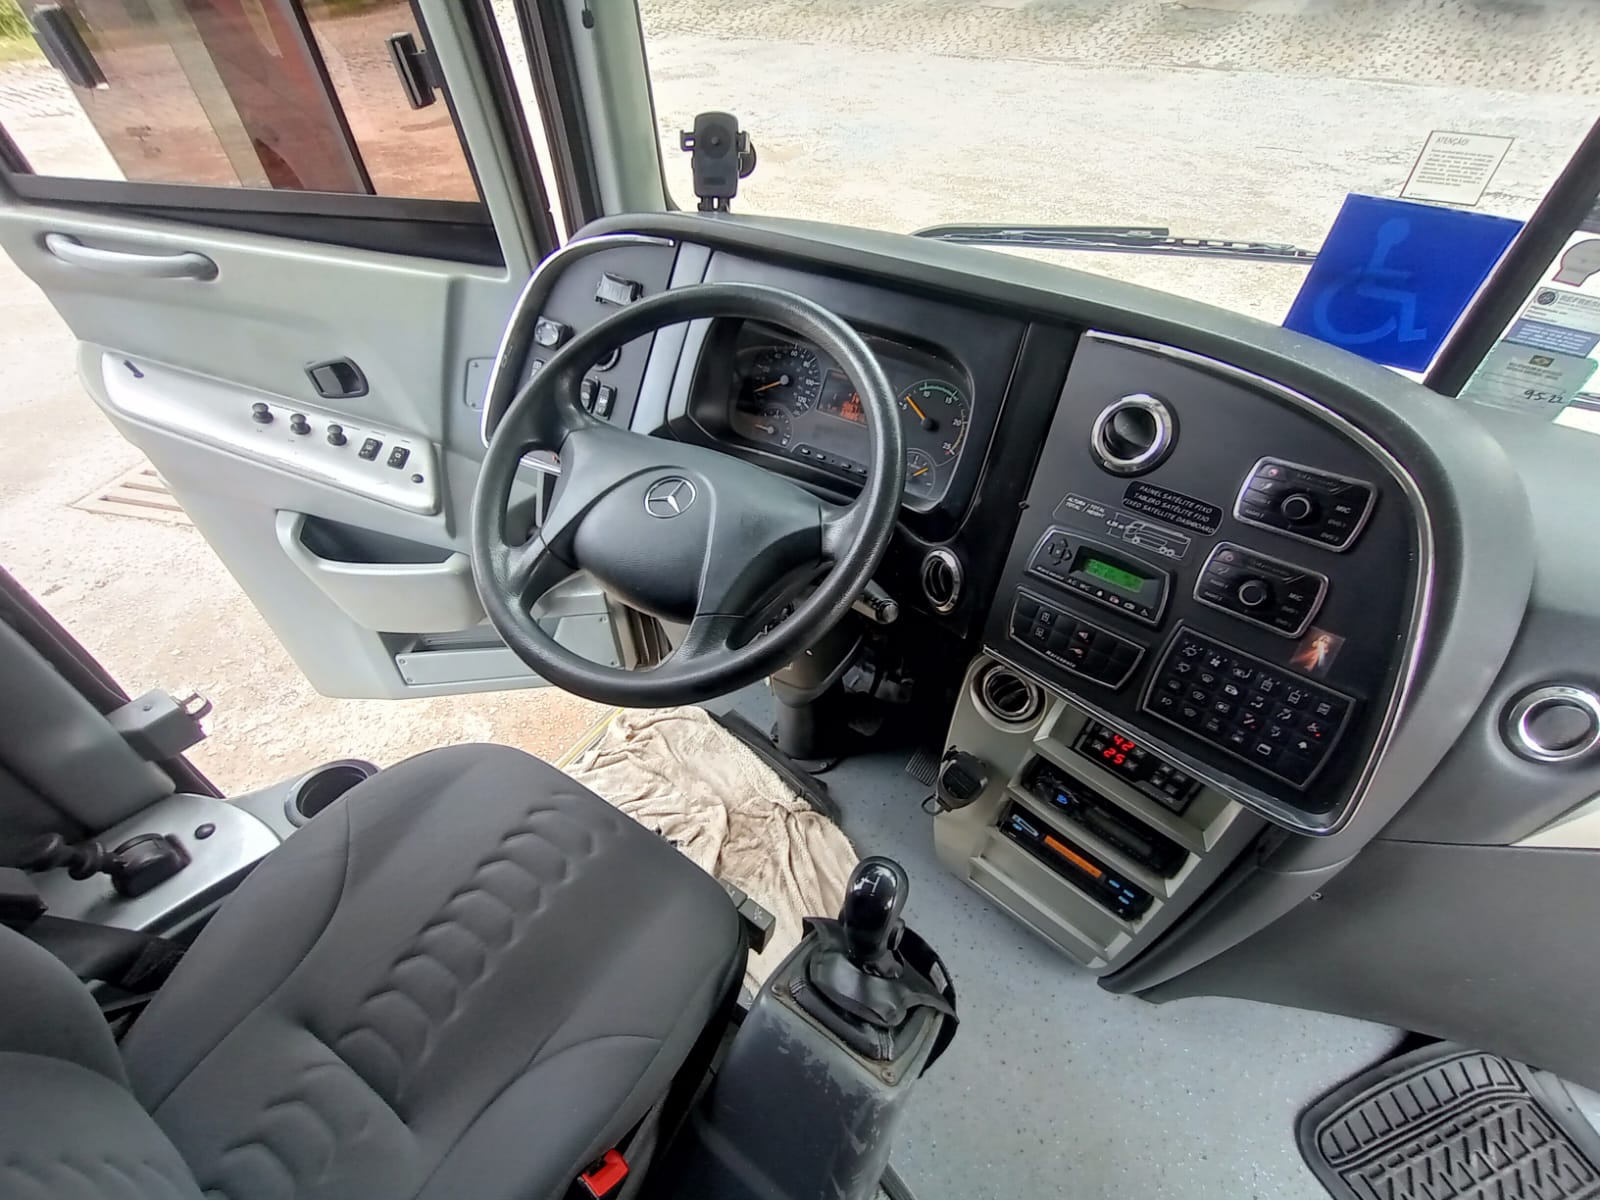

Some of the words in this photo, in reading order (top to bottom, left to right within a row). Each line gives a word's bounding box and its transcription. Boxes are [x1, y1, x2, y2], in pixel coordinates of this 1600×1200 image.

[945, 396, 953, 404] 15
[952, 418, 962, 427] 20
[1134, 493, 1161, 506] TABLERO
[1139, 486, 1161, 497] PAINEL
[1194, 504, 1213, 514] FIXO
[1123, 498, 1142, 508] FIXED
[1143, 505, 1176, 520] SATELLITE
[1176, 516, 1215, 533] DASHBOARD
[1335, 505, 1351, 514] MIC
[1288, 592, 1304, 602] MIC
[1113, 734, 1136, 751] 42
[1103, 747, 1126, 764] 25
